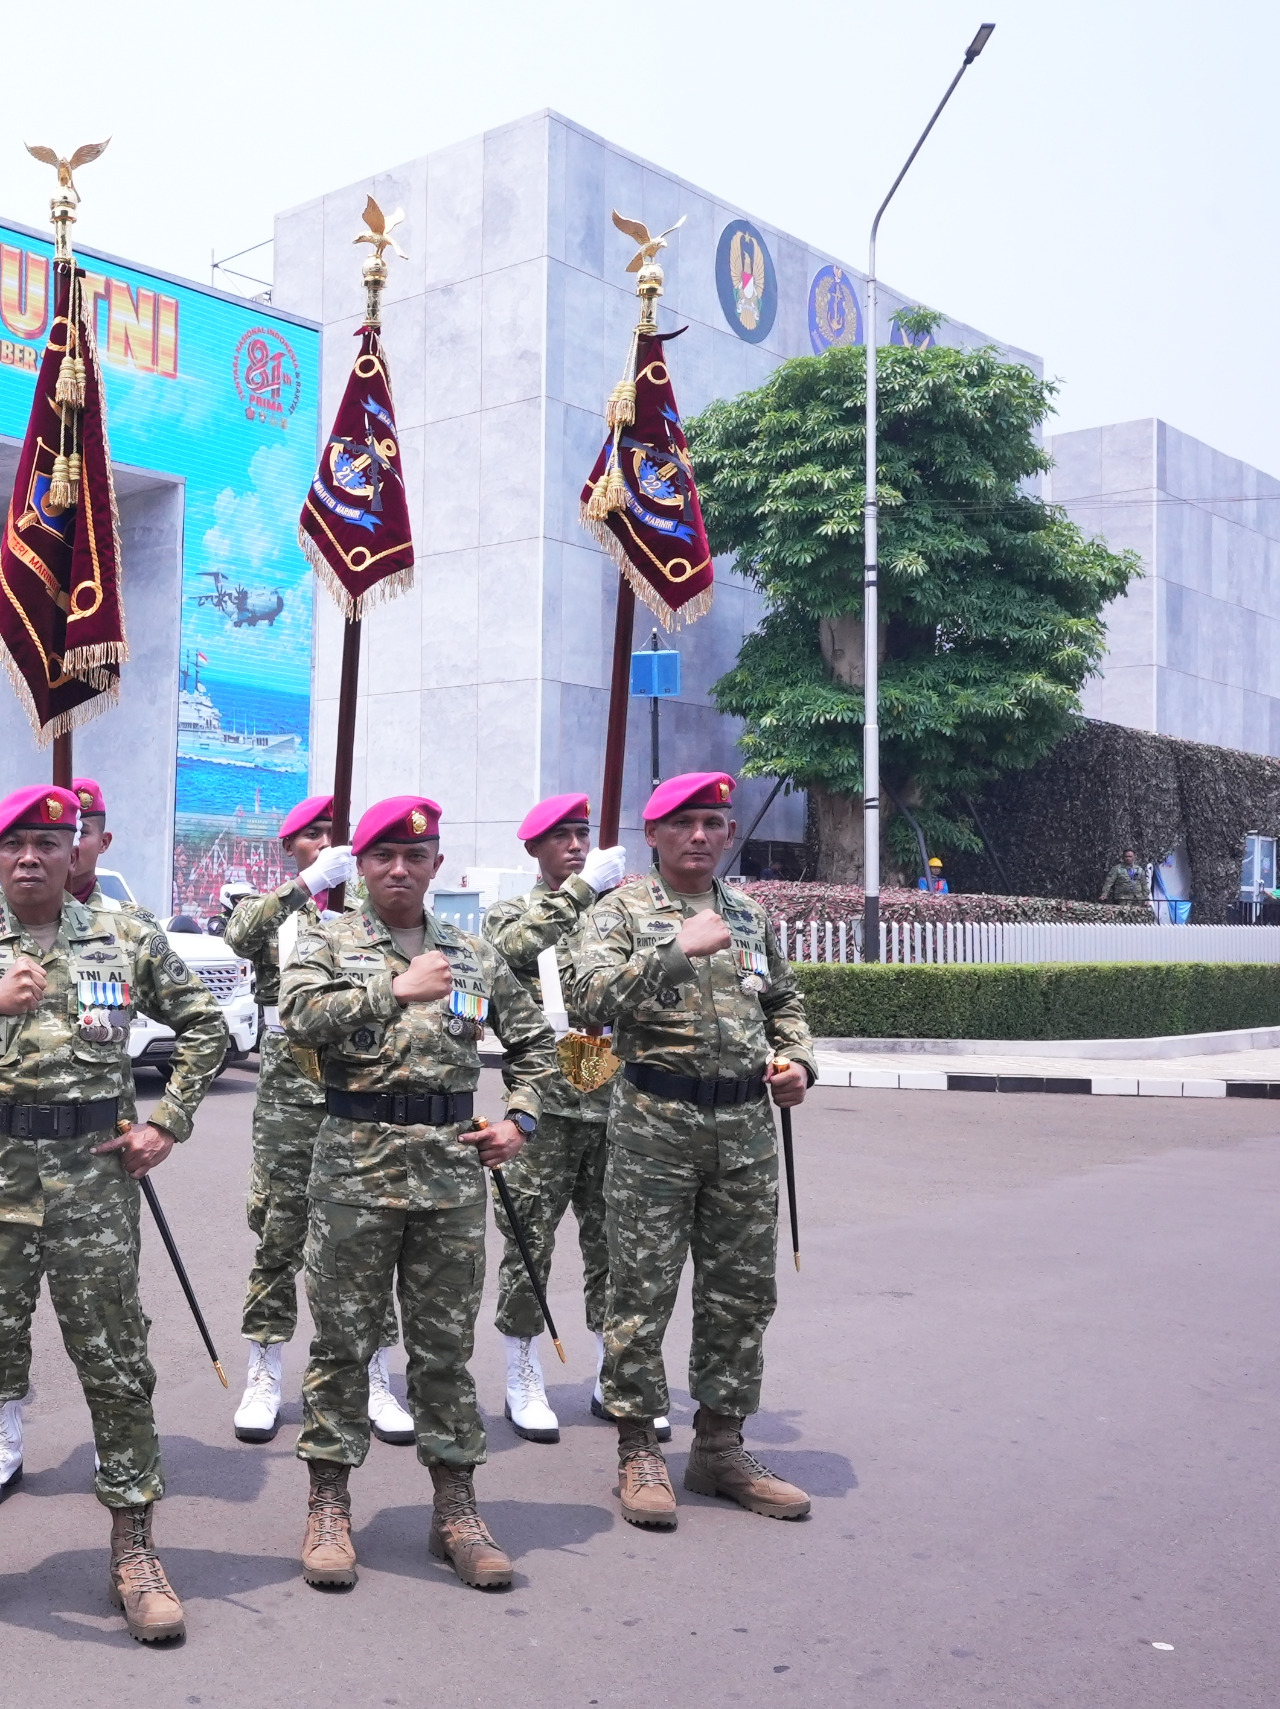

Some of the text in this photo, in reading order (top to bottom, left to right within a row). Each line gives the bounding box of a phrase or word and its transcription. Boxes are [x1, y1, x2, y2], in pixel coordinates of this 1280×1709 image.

[249, 394, 283, 412] PRIMA
[288, 381, 302, 416] RAKYAT
[336, 465, 355, 486] 21
[641, 474, 661, 494] 22
[335, 503, 361, 519] MARINIR
[644, 514, 674, 530] MARINIR
[733, 938, 751, 950] TNI
[77, 970, 126, 983] TNI AL
[472, 981, 486, 994] AL
